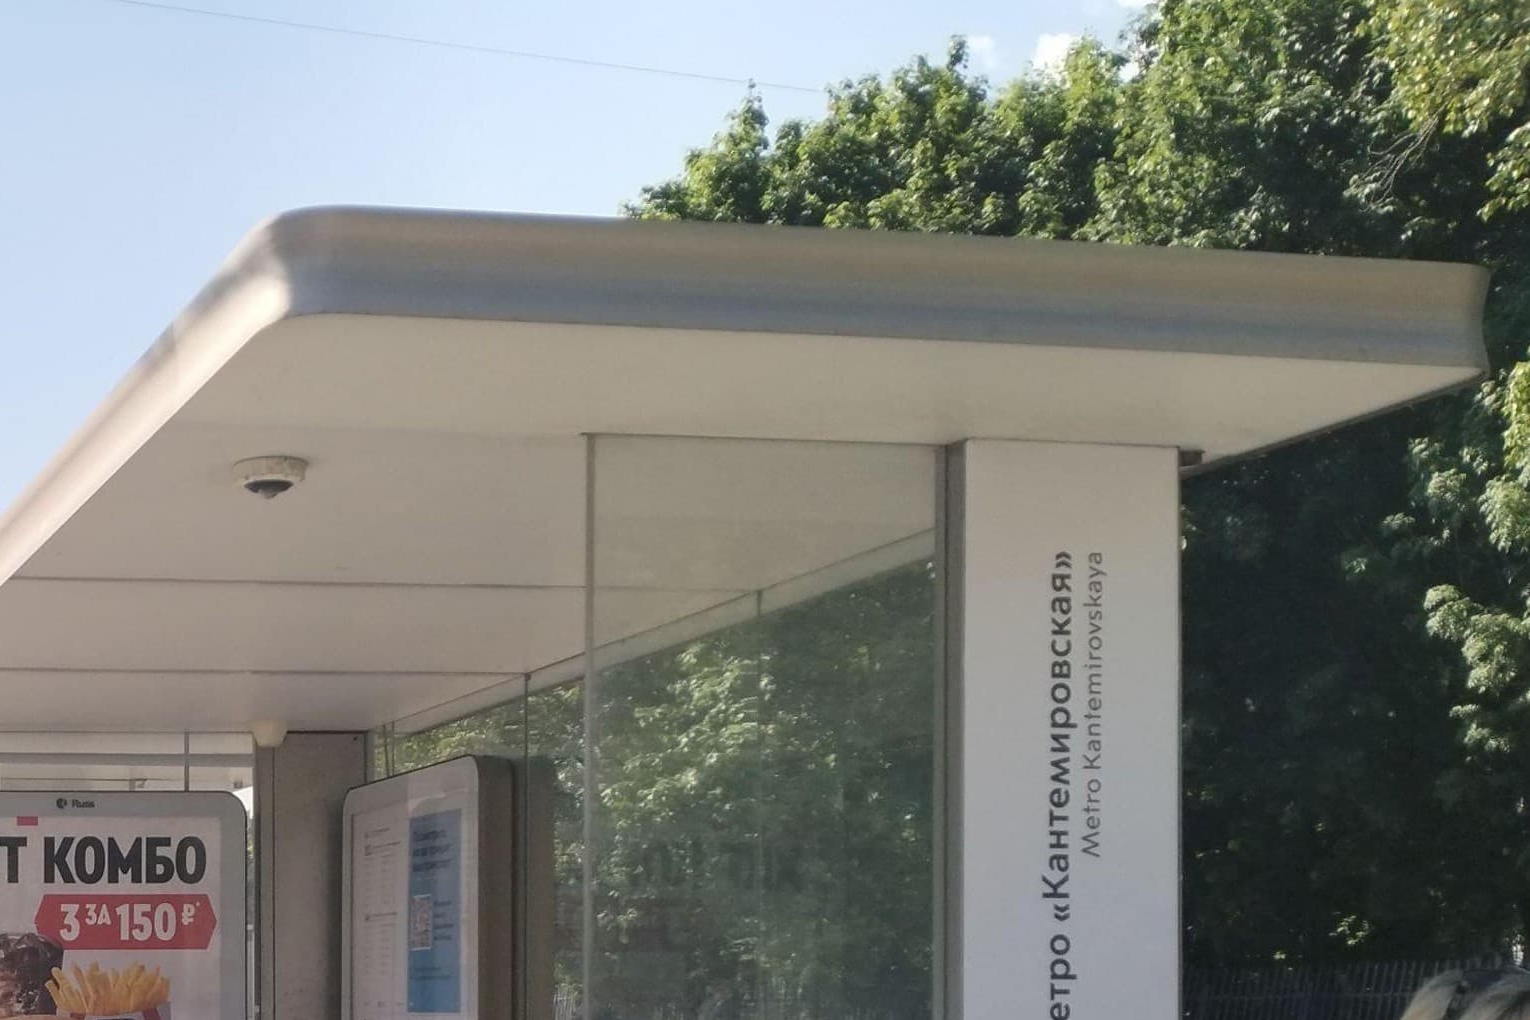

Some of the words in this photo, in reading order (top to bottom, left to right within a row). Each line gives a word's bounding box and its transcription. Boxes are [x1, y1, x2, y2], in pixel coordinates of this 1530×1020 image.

[1082, 551, 1107, 775] Kantemirovskaya
[1042, 551, 1077, 922] «Кантемировская»
[1081, 778, 1103, 858] Metro
[43, 836, 207, 884] КОМБО
[60, 904, 80, 941] 3
